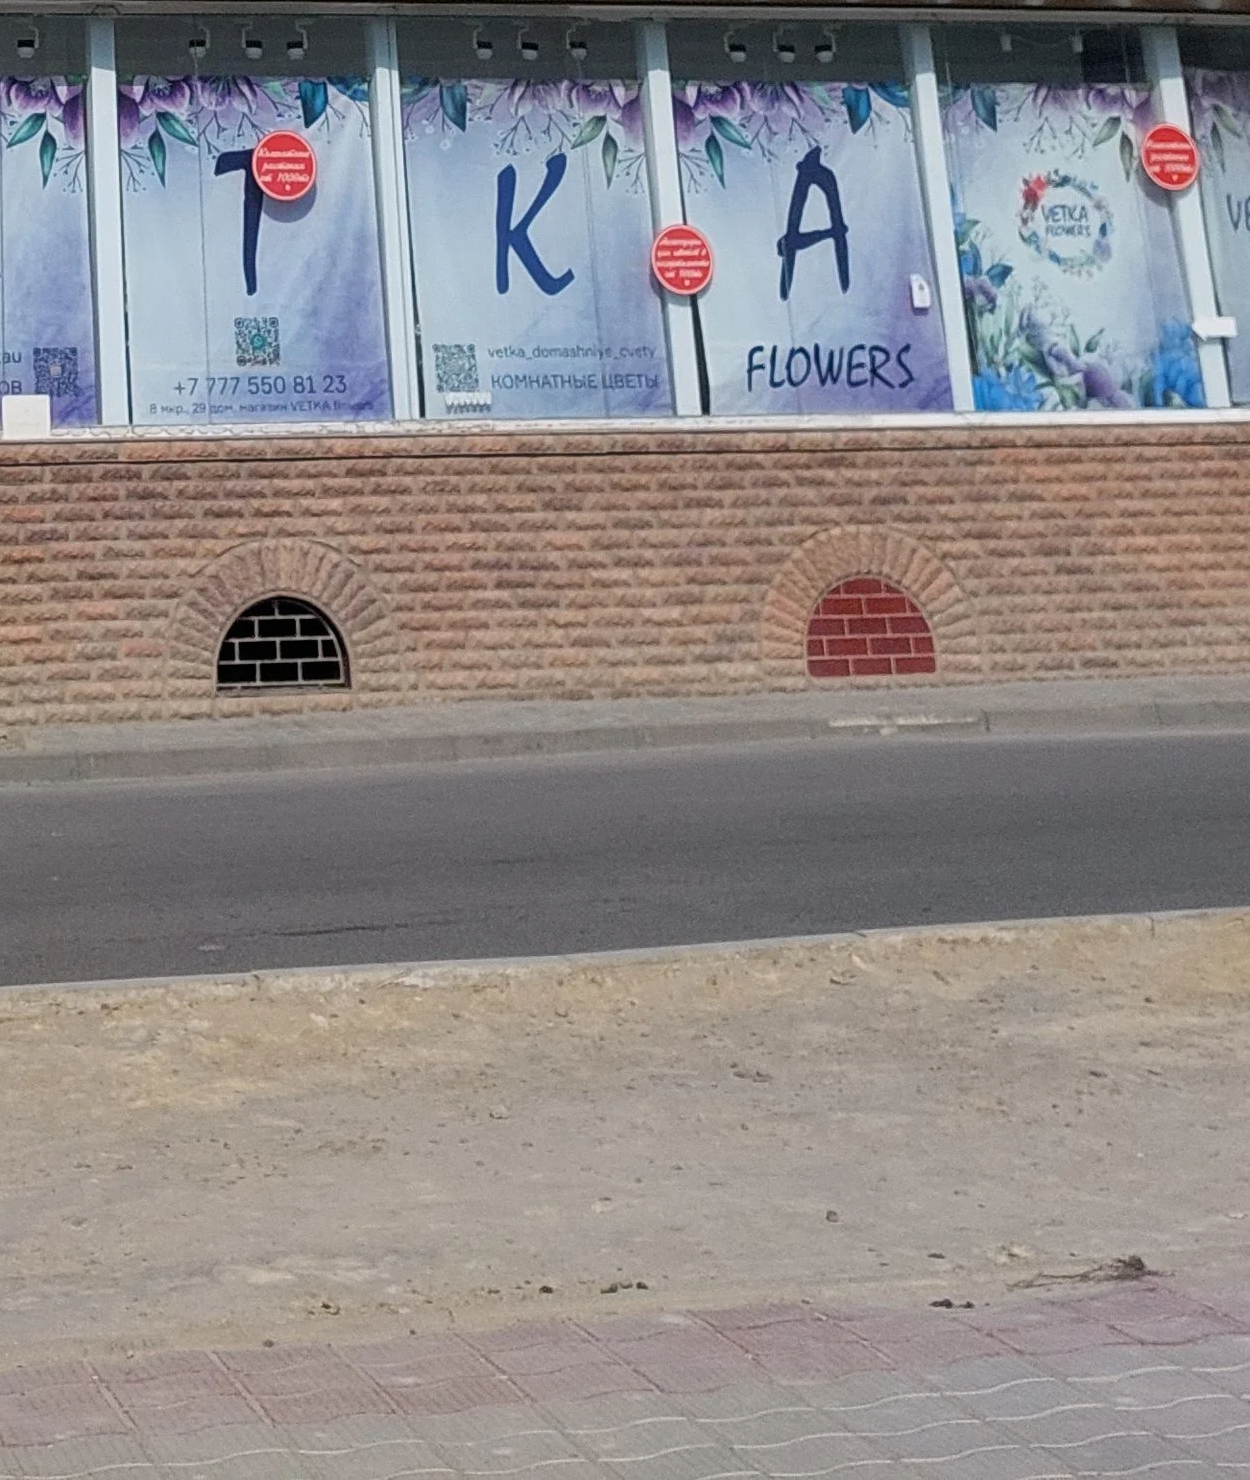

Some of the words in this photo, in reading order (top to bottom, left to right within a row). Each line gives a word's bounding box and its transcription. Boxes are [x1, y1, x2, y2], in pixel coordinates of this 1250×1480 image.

[1041, 204, 1090, 225] VETKA
[747, 342, 915, 392] FLOWERS
[173, 377, 199, 396] +7
[207, 376, 241, 396] 777
[247, 375, 286, 394] 550
[293, 374, 317, 394] 81
[322, 374, 348, 394] 23
[491, 373, 598, 390] КОМНАТНЫЕ
[601, 373, 658, 389] ЦВЕТЫ
